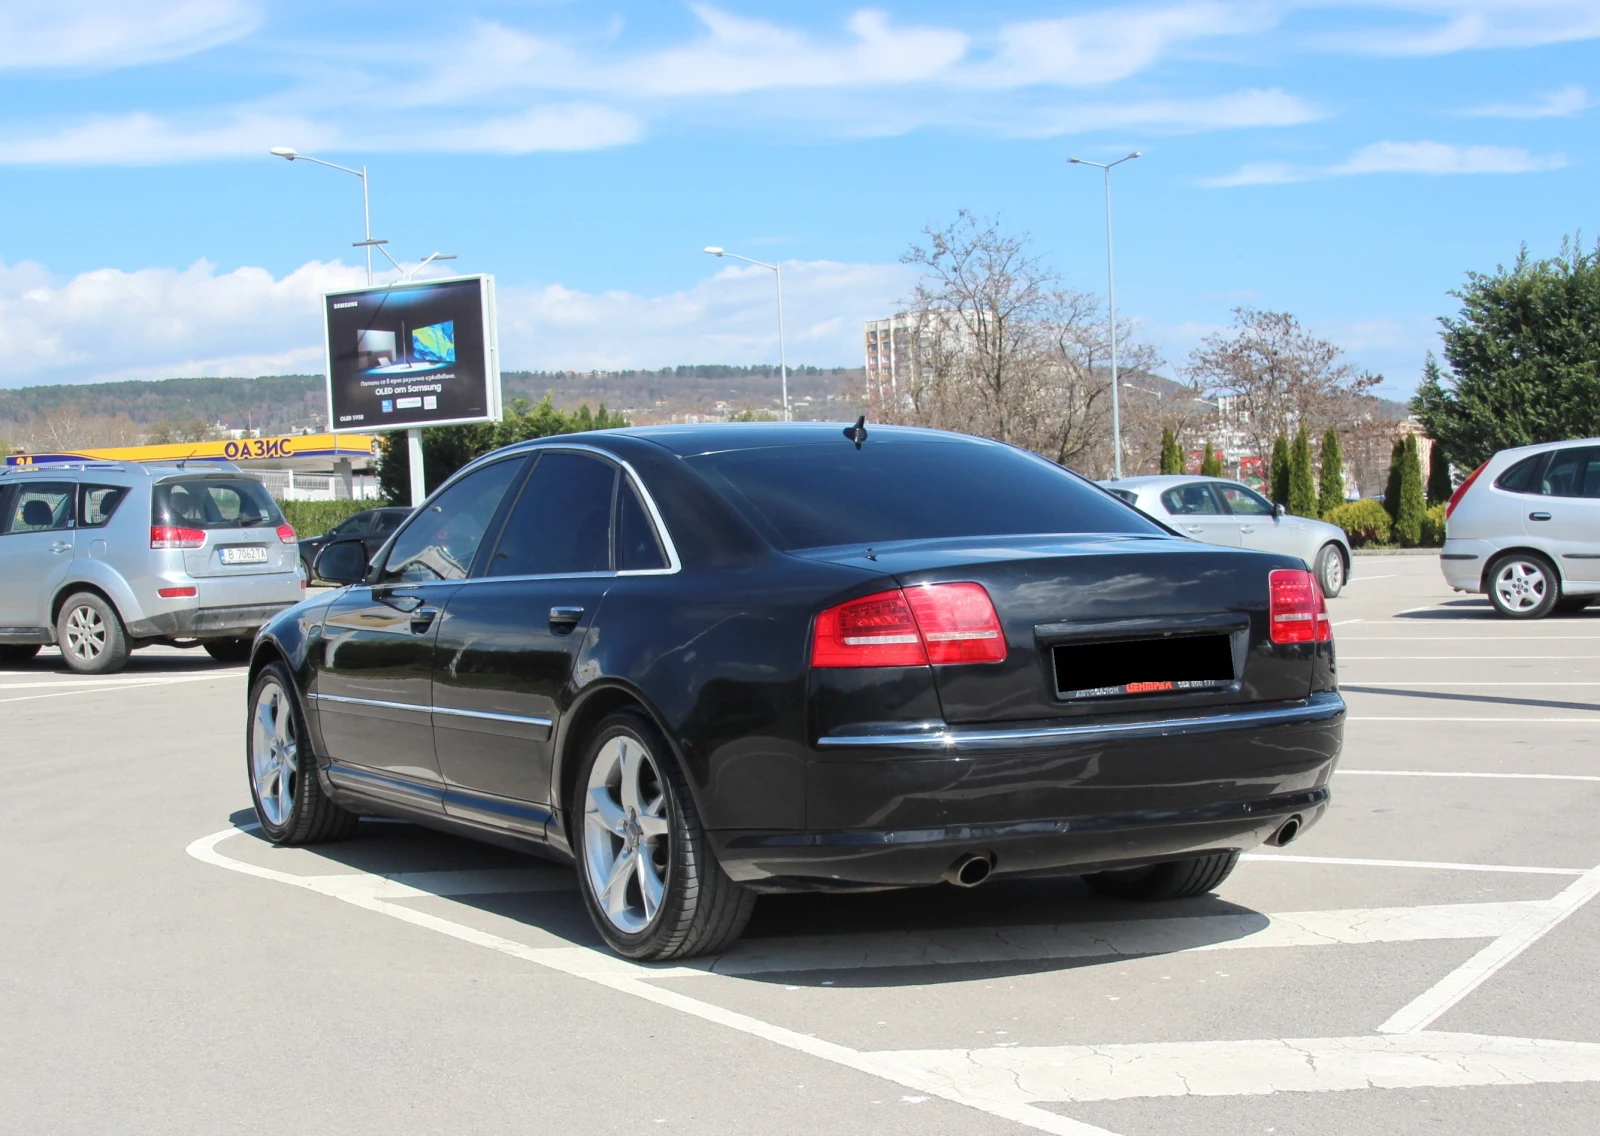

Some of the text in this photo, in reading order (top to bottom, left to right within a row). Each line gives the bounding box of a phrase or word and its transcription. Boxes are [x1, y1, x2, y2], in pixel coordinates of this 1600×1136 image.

[333, 301, 358, 309] SAMSUNG
[375, 387, 393, 396] OLED
[407, 383, 442, 393] Samsung
[224, 438, 292, 459] ОАЗИС
